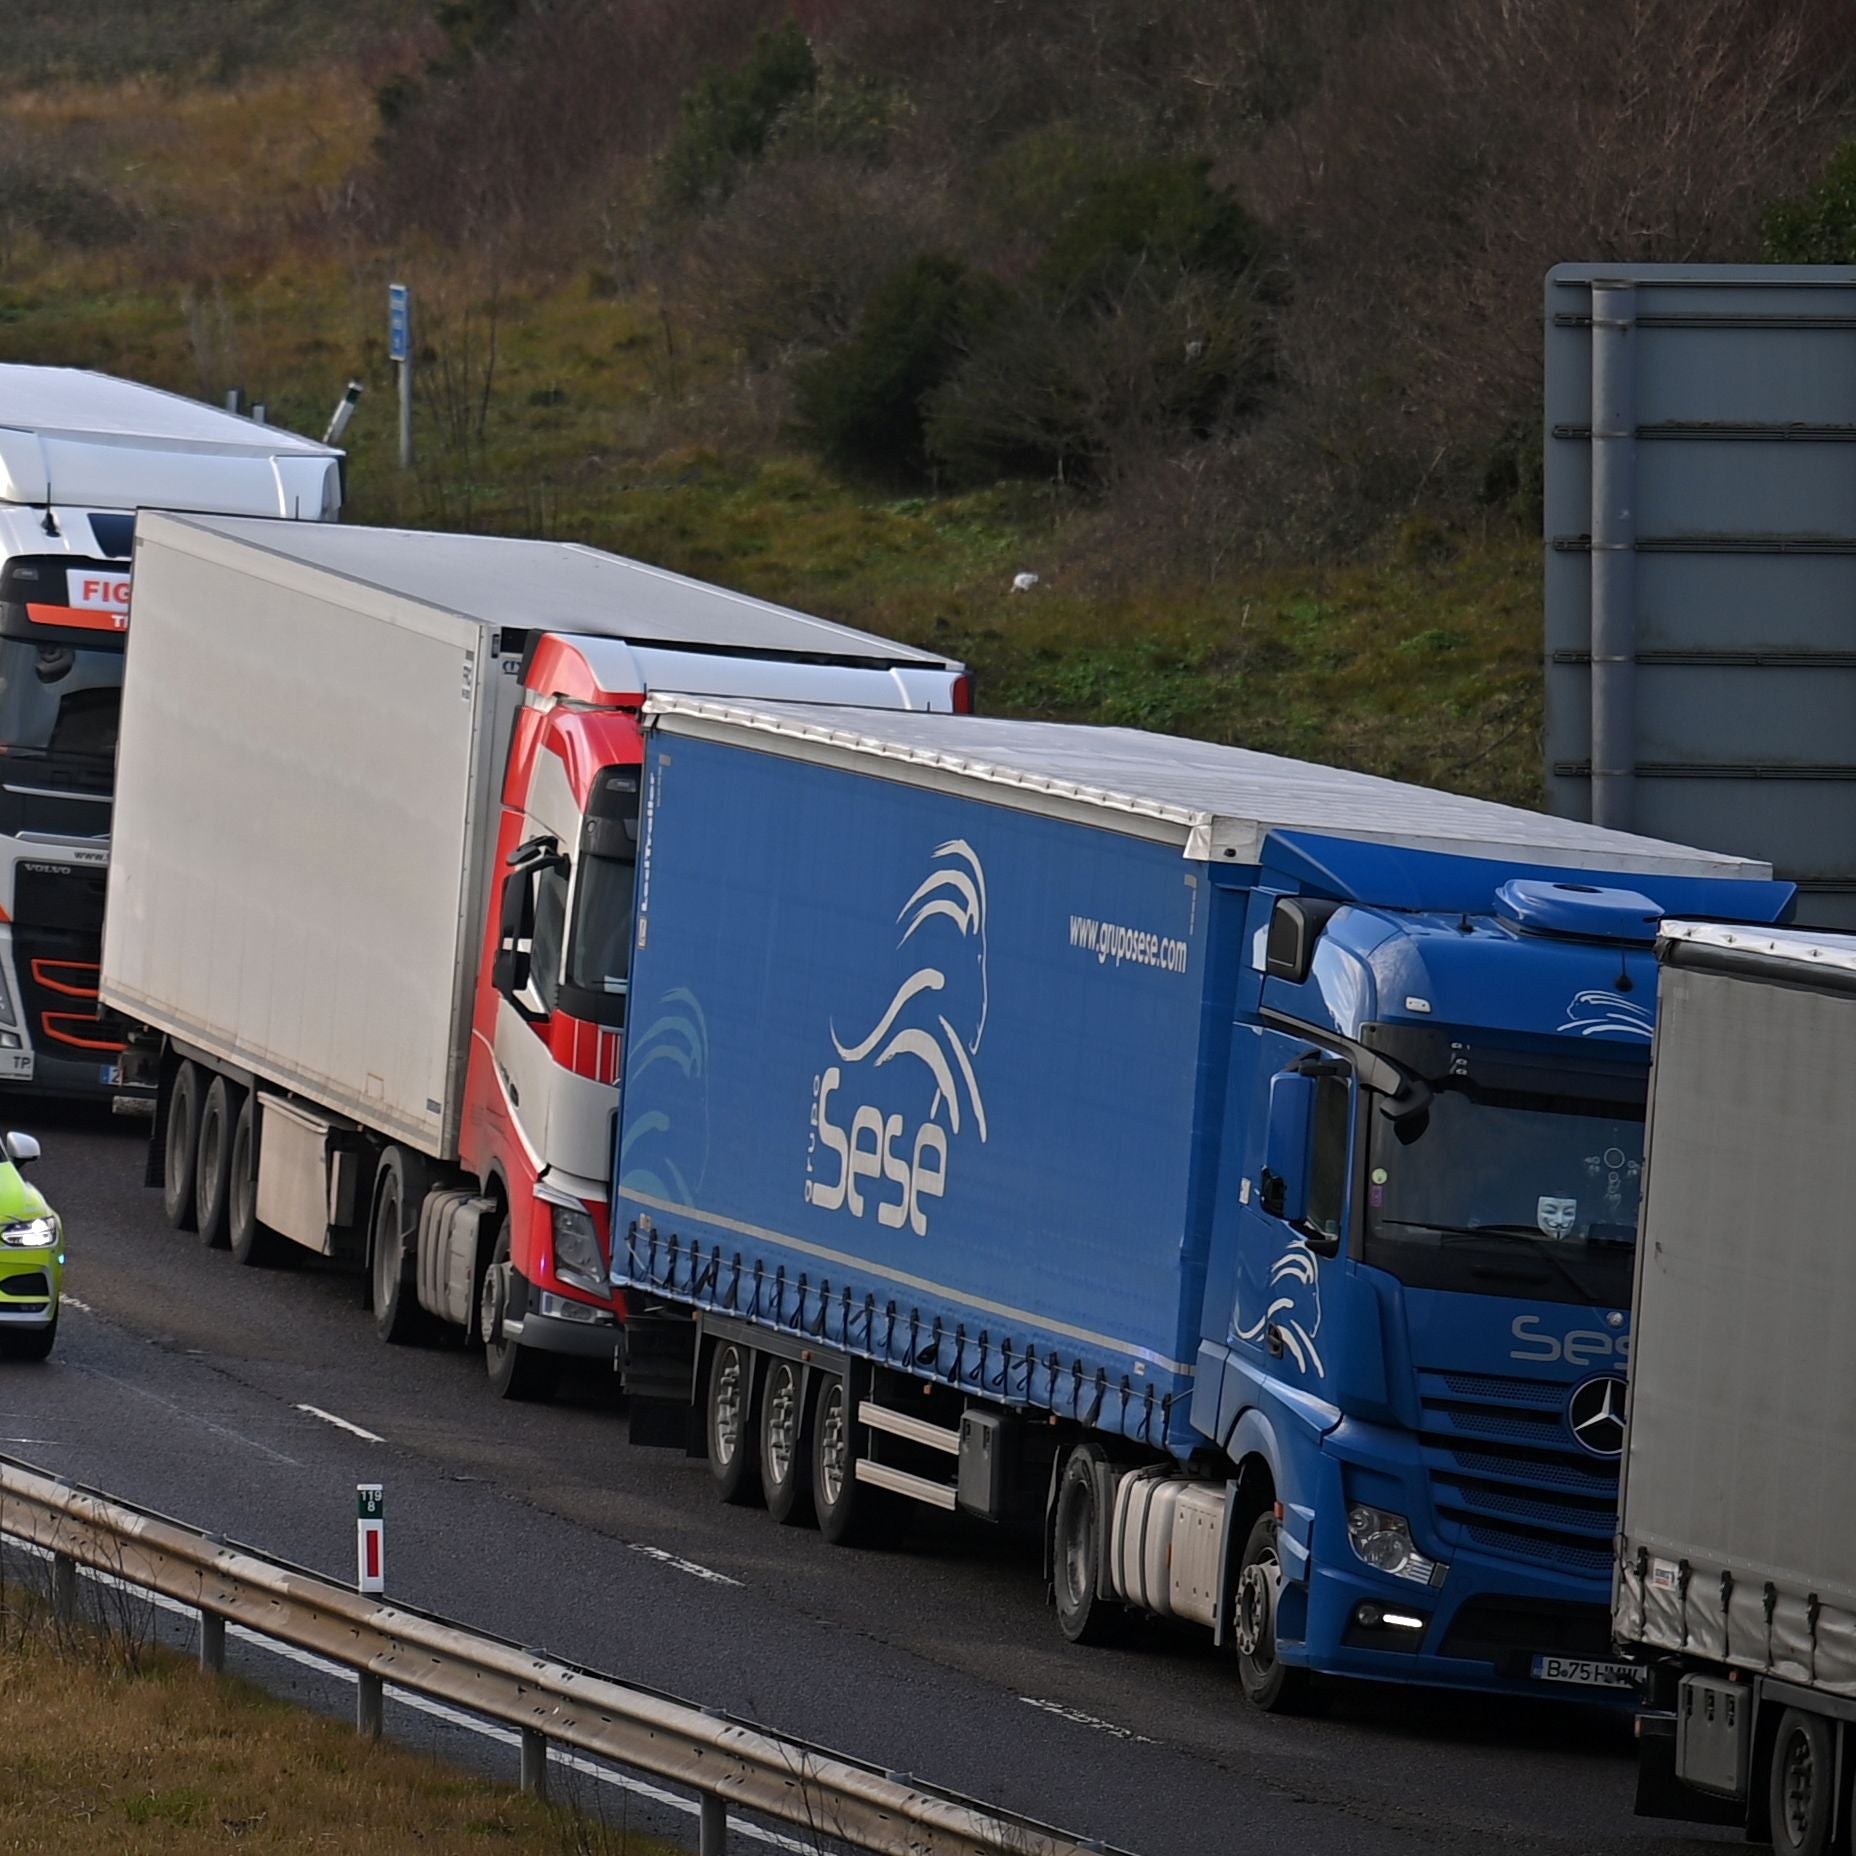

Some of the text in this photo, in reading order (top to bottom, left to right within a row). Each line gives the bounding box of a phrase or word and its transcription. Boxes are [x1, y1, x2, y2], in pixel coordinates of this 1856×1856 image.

[25, 864, 71, 875] VOLVO
[1069, 915, 1188, 974] www.gruposese.com
[361, 1490, 383, 1501] 119
[367, 1500, 376, 1512] 8
[1547, 1660, 1560, 1677] B
[1569, 1662, 1591, 1680] 75
